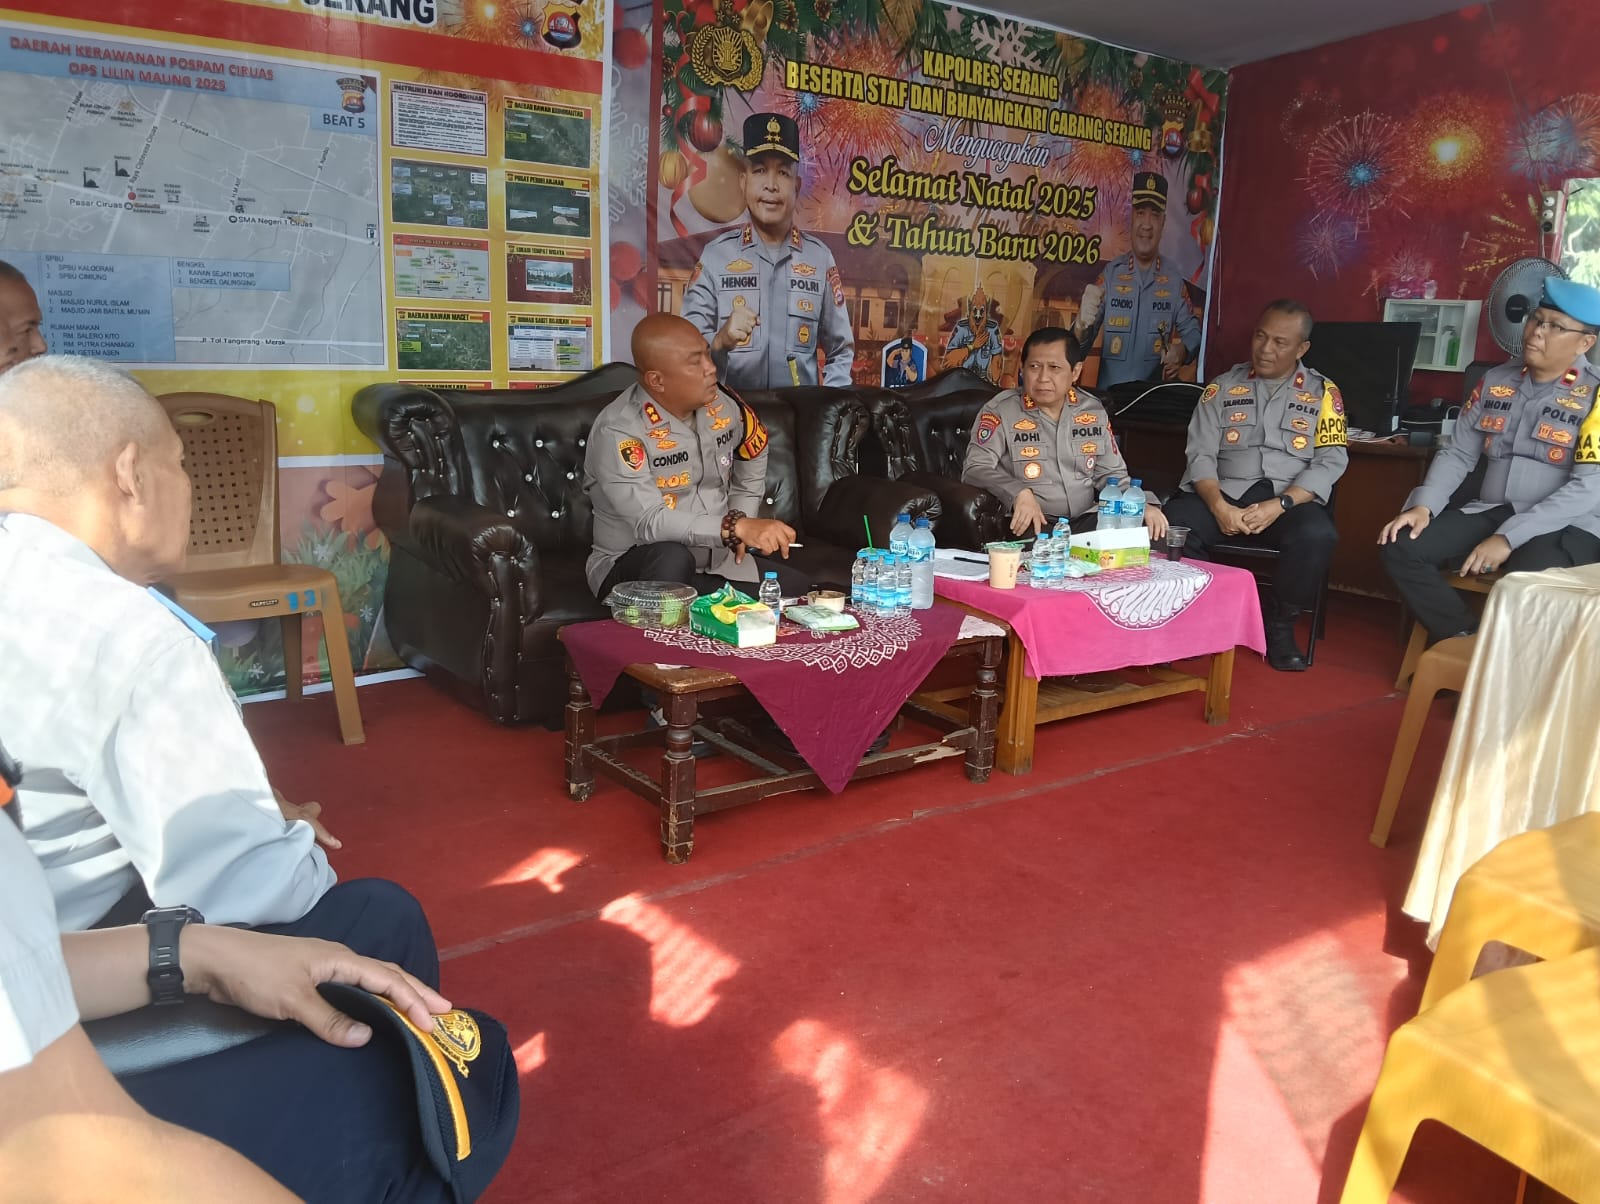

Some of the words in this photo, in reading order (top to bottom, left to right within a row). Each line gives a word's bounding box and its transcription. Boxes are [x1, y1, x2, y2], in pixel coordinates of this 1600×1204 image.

[303, 0, 435, 24] RANG
[10, 36, 71, 56] DAERAH
[75, 45, 166, 66] KERAWANAN
[169, 57, 225, 73] POSPAM
[229, 64, 274, 81] CIRUAS
[69, 62, 97, 77] OPS
[101, 66, 135, 81] LILIN
[138, 71, 192, 88] MAUNG
[924, 50, 999, 88] KAPOLRES
[1003, 67, 1058, 100] SERANG
[786, 61, 864, 101] BESERTA
[867, 75, 907, 108] STAF
[910, 84, 943, 114] DAN
[946, 91, 1048, 132] BHAYANGKARI
[1049, 109, 1103, 142] CABANG
[1105, 121, 1151, 150] SERANG
[323, 113, 353, 127] BEAT
[357, 118, 365, 128] 5
[924, 118, 1050, 173] Mengucapkan
[849, 158, 960, 204] Selamat
[965, 174, 1036, 211] Natal
[1038, 185, 1096, 220] 2025
[69, 198, 94, 207] Pasar
[96, 201, 122, 209] Ciruas
[258, 217, 281, 226] Negeri
[847, 214, 878, 246] &
[886, 216, 972, 255] Tahun
[977, 227, 1040, 260] Baru
[1042, 234, 1101, 265] 2026
[721, 277, 758, 288] HENGKI
[790, 279, 819, 292] POLRI
[1152, 302, 1172, 311] POLRI
[223, 338, 260, 346] Tangerang
[1287, 402, 1319, 417] POLRI
[1542, 406, 1581, 426] POLRI
[1014, 432, 1040, 443] ADHI
[1072, 427, 1101, 438] POLRI
[653, 450, 689, 468] CONDRO
